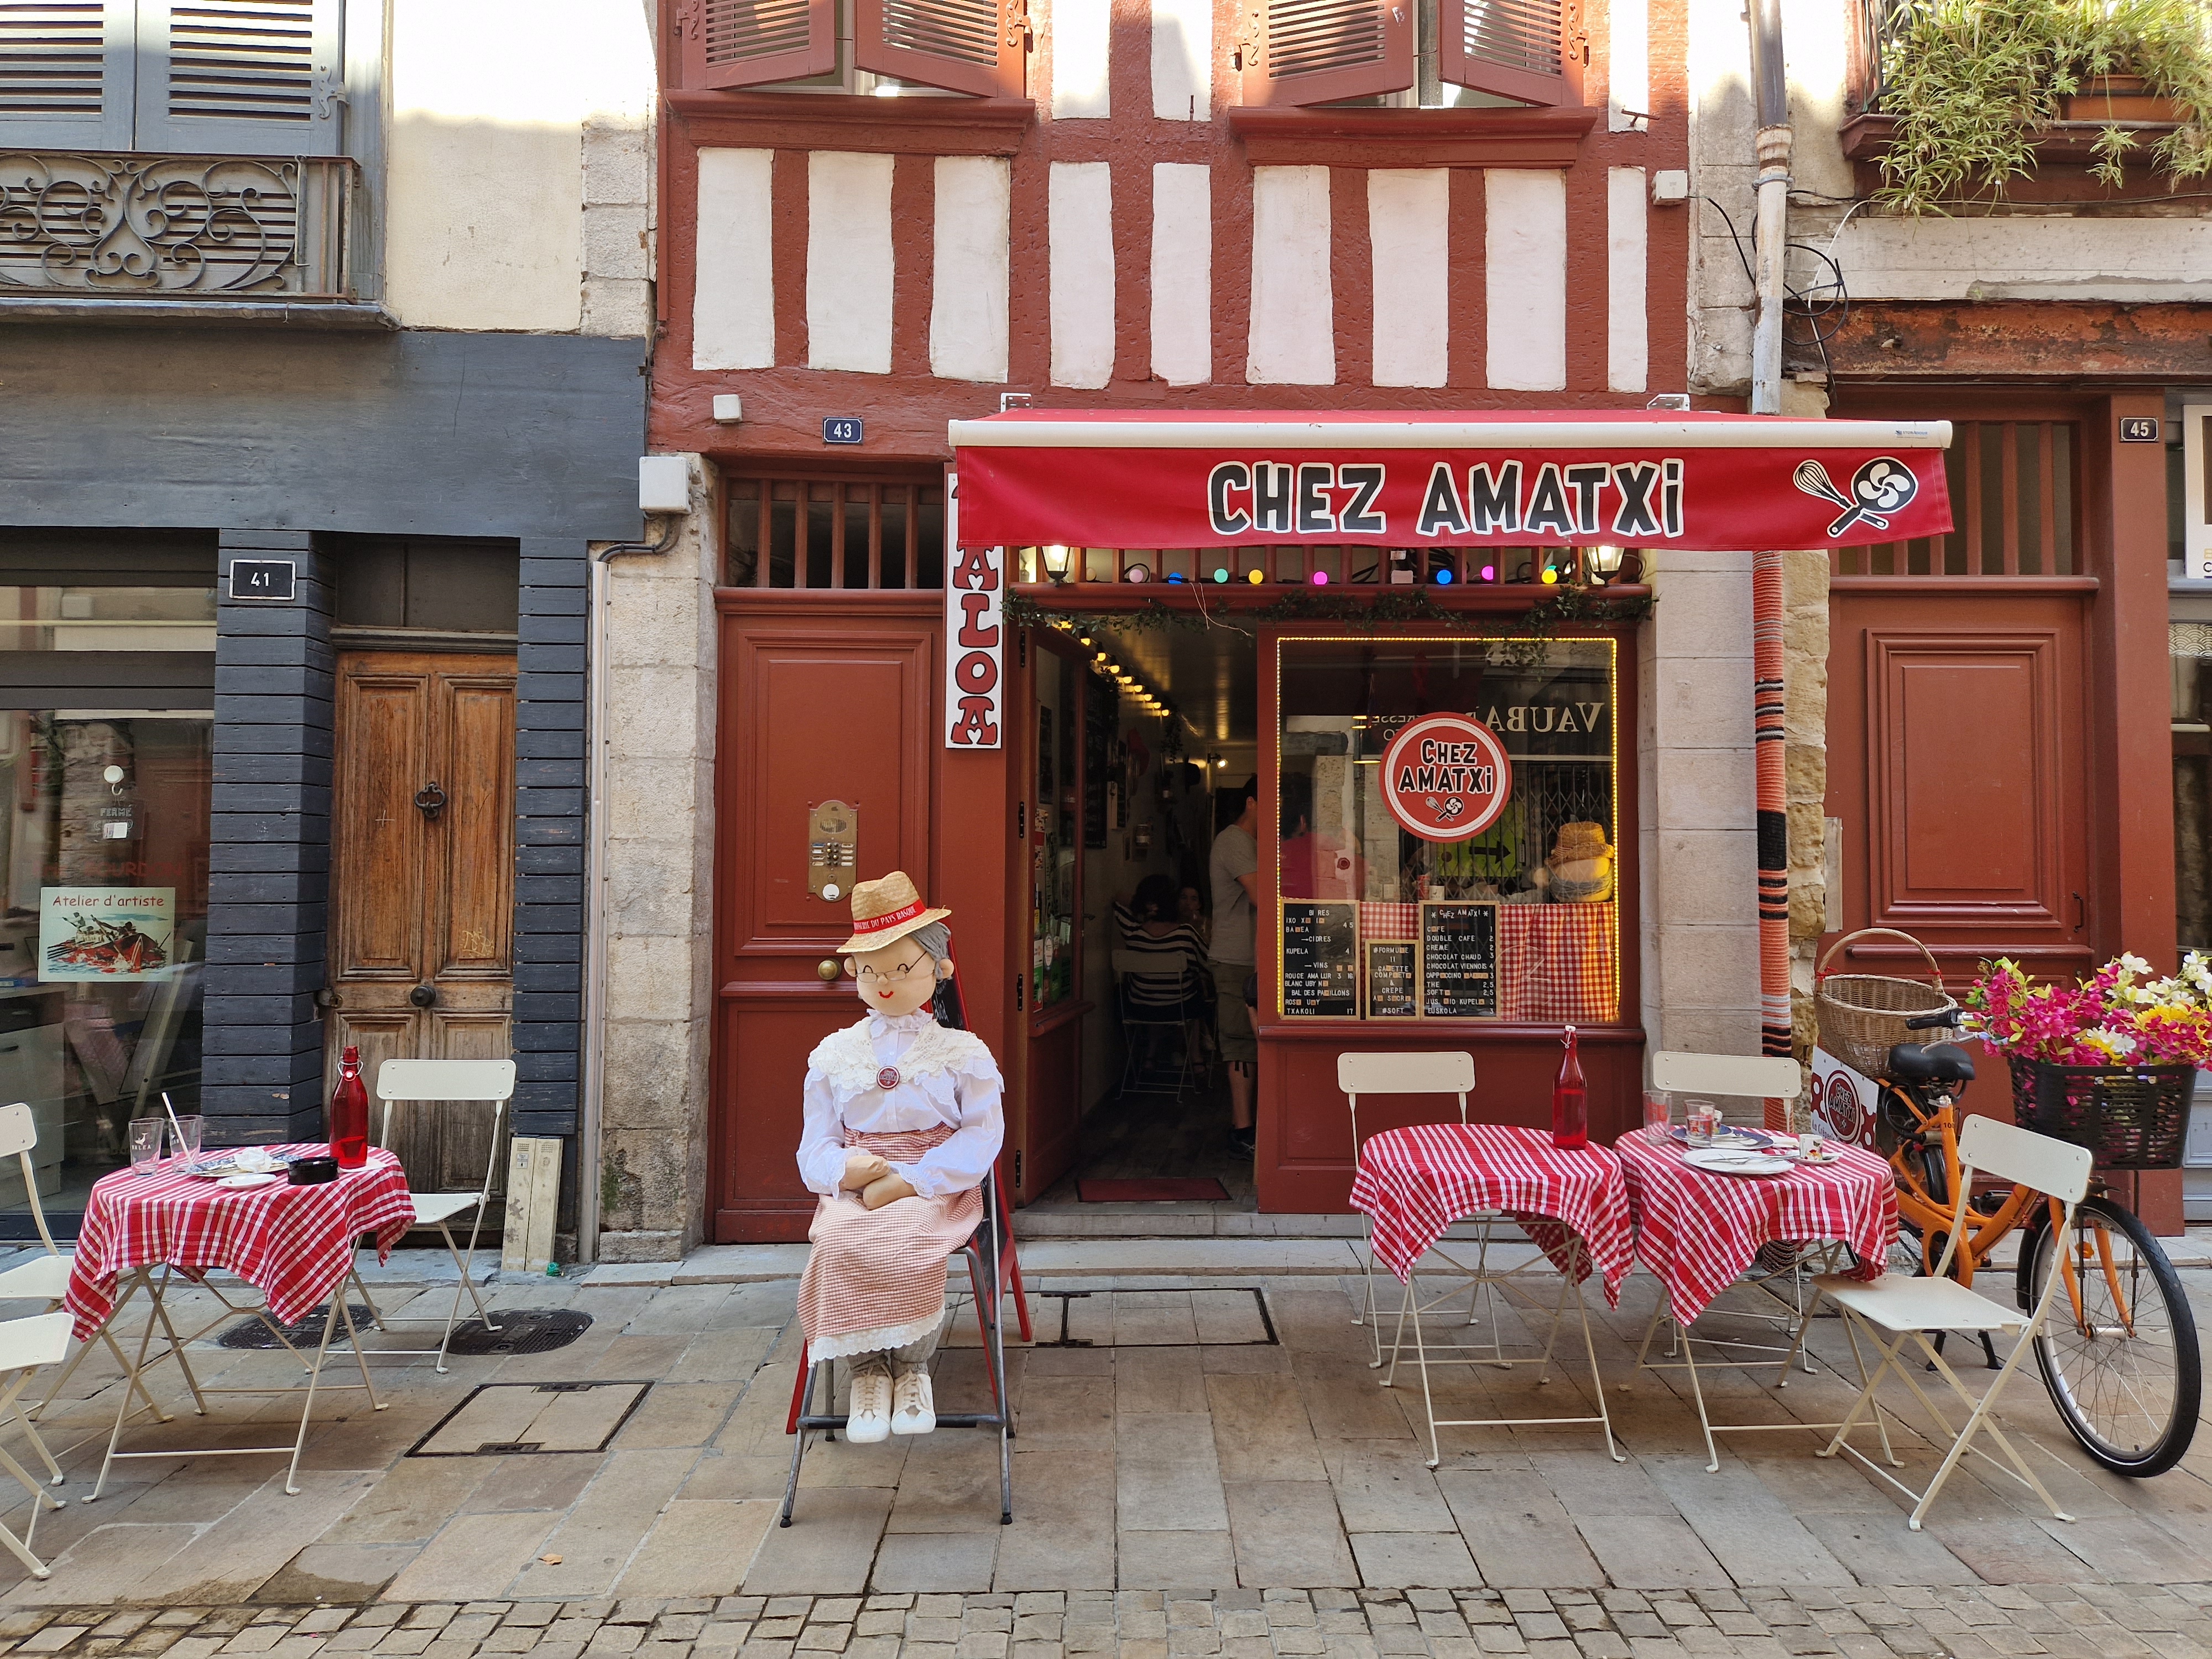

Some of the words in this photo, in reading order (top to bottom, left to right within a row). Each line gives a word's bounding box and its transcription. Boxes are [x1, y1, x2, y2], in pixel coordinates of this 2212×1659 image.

[833, 422, 852, 438] 43
[2130, 421, 2149, 437] 45
[1207, 460, 1387, 535] CHEZ
[251, 572, 270, 587] 41
[951, 485, 999, 745] ALOA
[1420, 737, 1478, 765] CHEZ
[53, 895, 99, 906] Atelier
[104, 894, 164, 906] d'artiste
[870, 919, 879, 928] DU
[880, 914, 896, 925] PAYS
[896, 905, 916, 920] BASQUE
[1439, 909, 1455, 919] CHEZ
[1457, 909, 1480, 917] AMATXI
[1835, 1083, 1853, 1106] CHEZ
